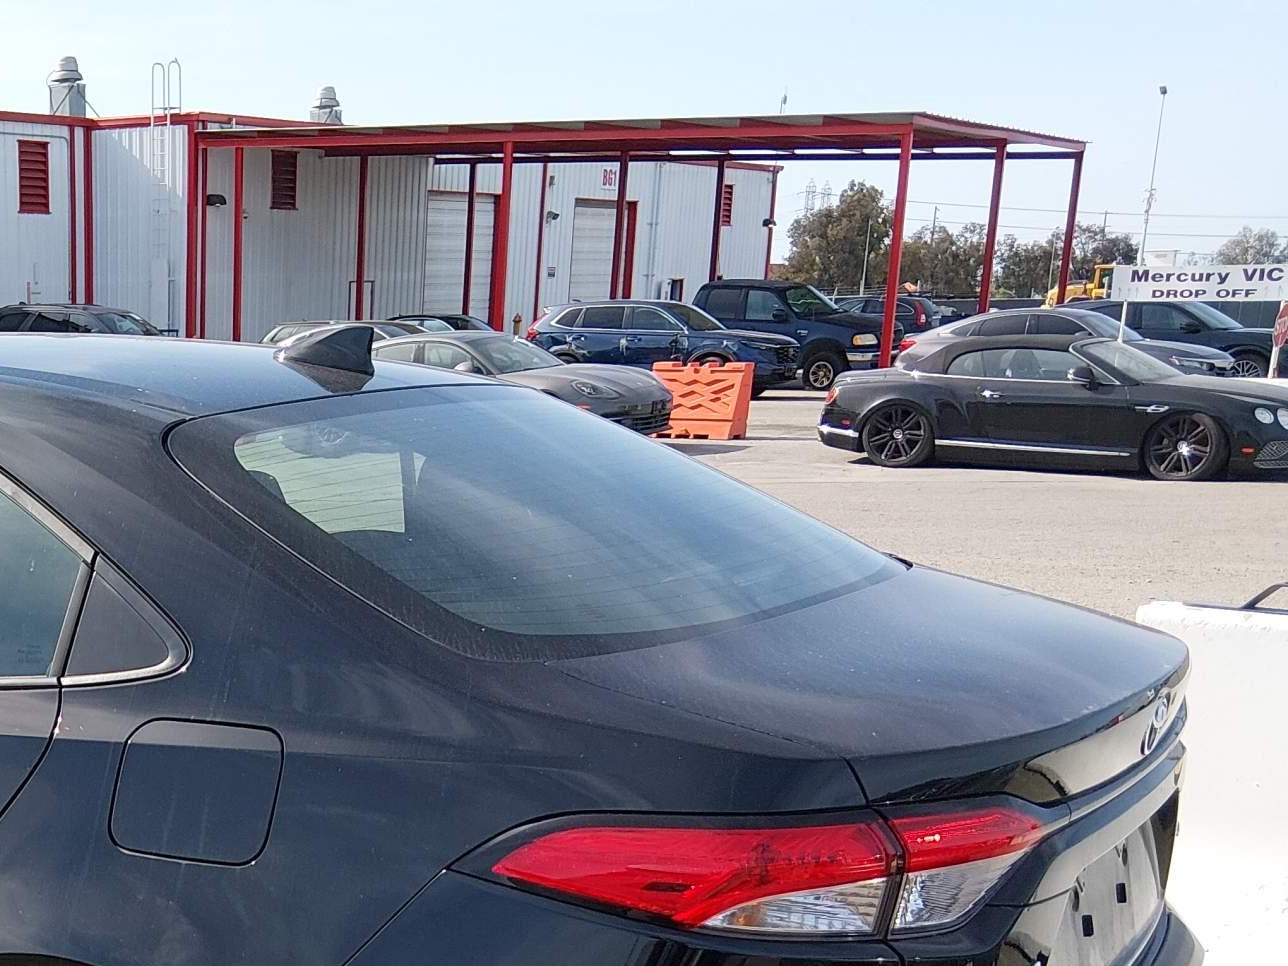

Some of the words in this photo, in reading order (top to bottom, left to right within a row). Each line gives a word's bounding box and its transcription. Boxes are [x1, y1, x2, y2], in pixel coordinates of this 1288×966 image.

[1130, 269, 1231, 285] Mercury
[1242, 267, 1285, 282] VIC
[1151, 289, 1207, 298] DROP
[1215, 288, 1258, 298] OFF
